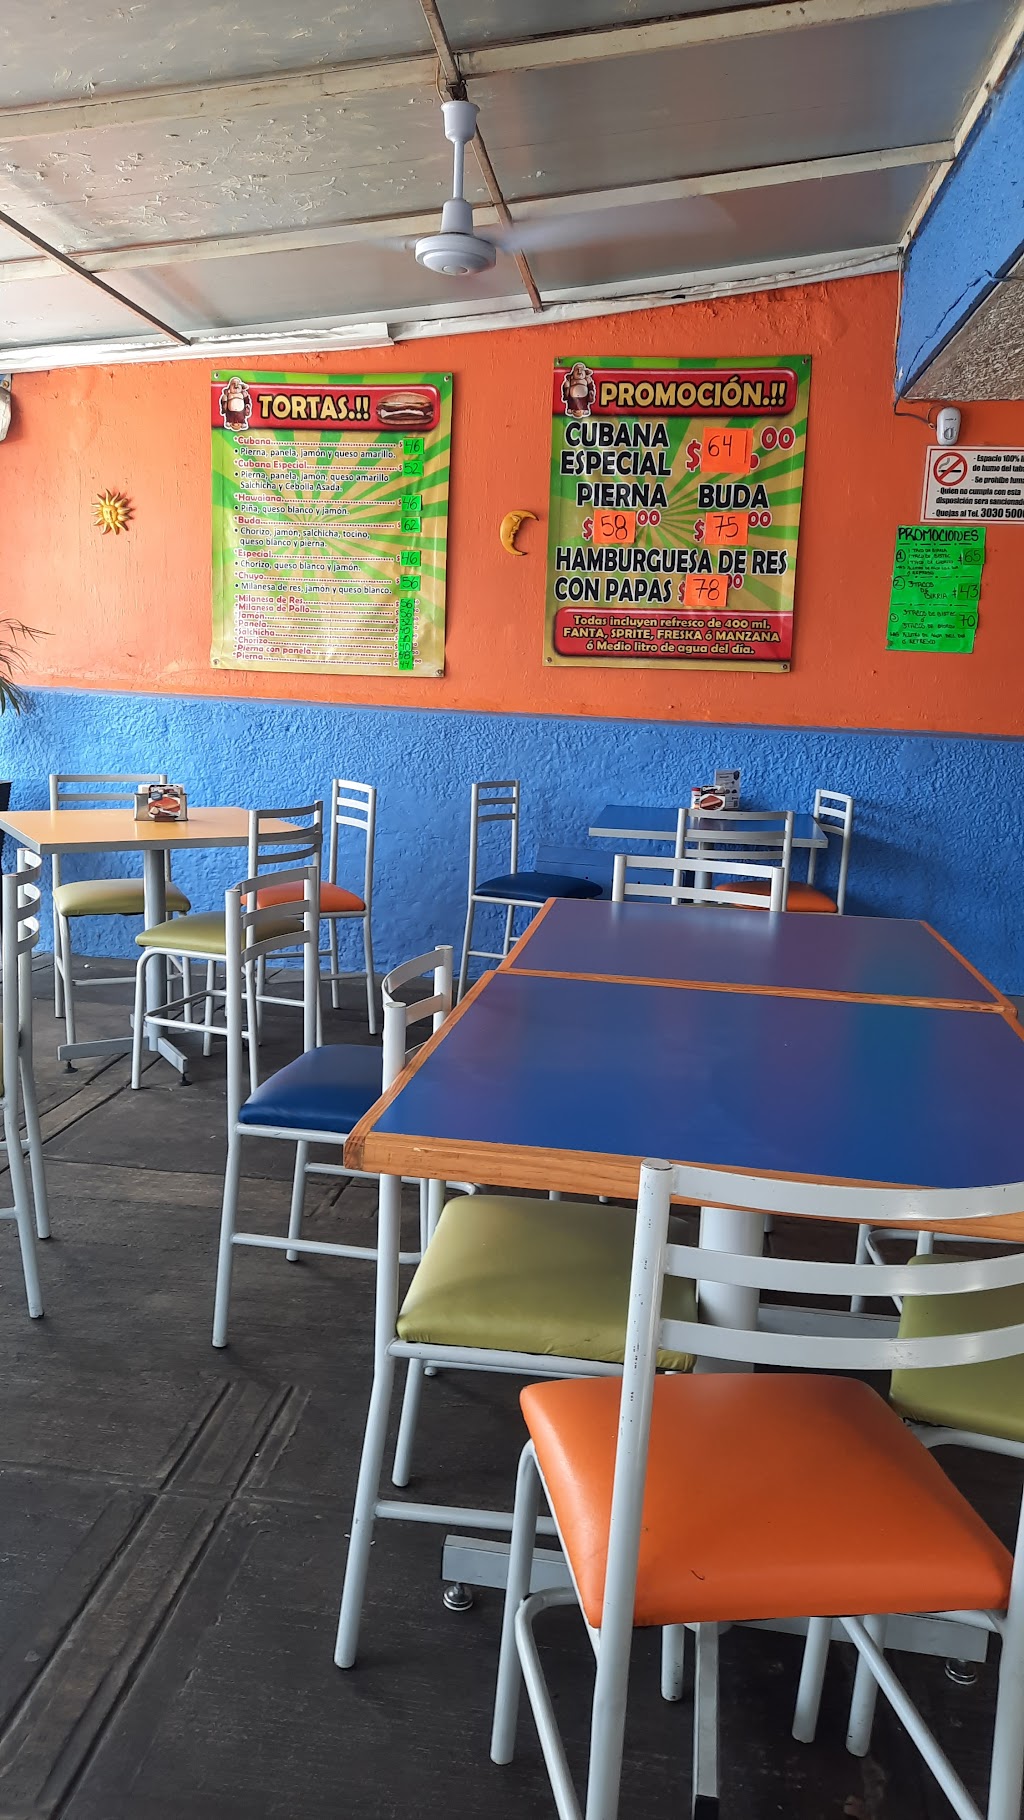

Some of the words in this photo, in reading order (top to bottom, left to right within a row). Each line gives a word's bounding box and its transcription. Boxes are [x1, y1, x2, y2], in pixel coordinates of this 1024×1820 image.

[600, 376, 787, 407] PROMOCIÓN.!!
[259, 395, 370, 420] TORTAS.!!
[565, 422, 670, 448] CUBANA
[240, 449, 268, 457] Pierna,
[270, 449, 298, 458] panela,
[301, 448, 325, 458] jamón
[327, 451, 332, 459] y
[334, 451, 359, 459] queso
[360, 449, 396, 458] amarillo.
[977, 454, 1002, 462] Espacio
[1003, 454, 1020, 462] 100%
[561, 451, 671, 476] ESPECIAL
[982, 464, 1000, 472] humo
[1001, 464, 1012, 472] del
[241, 471, 269, 480] Pierna,
[271, 472, 298, 481] panela,
[301, 471, 328, 481] jamón,
[330, 474, 354, 482] queso
[356, 472, 389, 481] amarillo
[240, 481, 276, 490] Salchicha
[278, 483, 283, 491] y
[285, 482, 314, 490] Cebolla
[316, 483, 342, 491] Asada.
[576, 483, 667, 507] PIERNA
[698, 484, 768, 509] BUDA
[241, 505, 260, 513] Piña,
[262, 507, 285, 515] queso
[287, 506, 314, 514] blanco
[316, 508, 320, 516] y
[322, 506, 349, 516] jamón.
[936, 508, 959, 517] Quejas
[980, 508, 1004, 518] 3030
[241, 527, 272, 537] Chorizo,
[274, 528, 301, 538] jamón,
[303, 529, 341, 538] salchicha,
[343, 530, 370, 539] tocino,
[240, 539, 264, 547] queso
[266, 538, 292, 546] blanco
[294, 540, 298, 548] y
[300, 539, 327, 548] pierna.
[241, 561, 272, 569] Chorizo,
[274, 562, 298, 570] queso
[299, 561, 326, 570] blanco
[333, 563, 361, 572] jamón.
[556, 548, 712, 574] HAMBURGUESA
[718, 550, 747, 574] DE
[752, 550, 788, 575] RES
[241, 583, 275, 591] Milanesa
[278, 583, 287, 592] de
[289, 585, 303, 593] res,
[305, 585, 330, 594] jamón
[339, 586, 362, 595] queso
[364, 585, 392, 594] blanco.
[555, 577, 599, 602] CON
[605, 578, 672, 603] PAPAS
[574, 616, 607, 626] Todas
[610, 617, 658, 629] incluyen
[660, 619, 704, 628] refresco
[707, 619, 722, 628] de
[725, 619, 749, 629] 400
[751, 619, 771, 629] ml.
[563, 628, 608, 639] FANTA,
[610, 629, 654, 640] SPRITE,
[657, 630, 702, 640] FRESKA
[705, 630, 712, 640] ó
[715, 631, 780, 642] MANZANA
[586, 640, 593, 651] ó
[596, 641, 631, 651] Medio
[634, 642, 658, 652] litro
[660, 642, 676, 652] de
[678, 644, 708, 654] agua
[710, 643, 729, 653] del
[732, 643, 755, 654] día.
